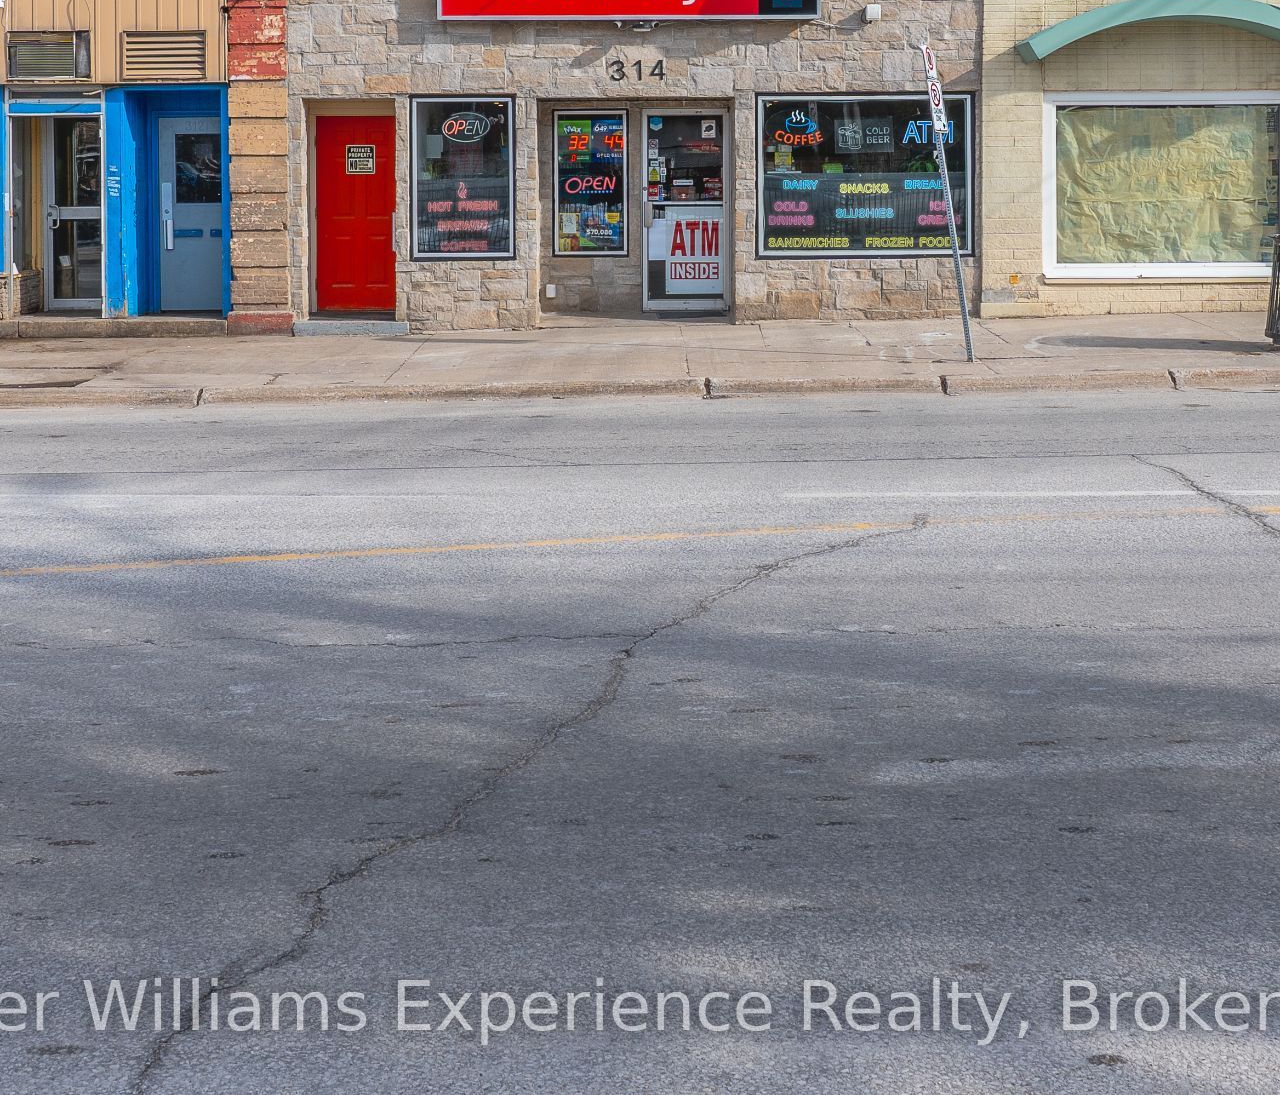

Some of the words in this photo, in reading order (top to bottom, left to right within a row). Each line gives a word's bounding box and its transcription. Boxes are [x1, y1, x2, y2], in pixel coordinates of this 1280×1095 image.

[609, 59, 666, 82] 314
[444, 119, 485, 135] OPEN
[866, 126, 890, 135] COLD
[568, 135, 589, 150] 32
[775, 130, 823, 145] COFFEE
[866, 135, 890, 144] BEER
[349, 159, 358, 170] NO
[565, 175, 616, 194] OPEN
[782, 179, 818, 190] DAIRY
[839, 182, 889, 194] SNACKS
[427, 200, 453, 212] HOT
[457, 199, 498, 212] FRESH
[773, 201, 808, 212] COLD
[835, 207, 894, 219] SLUSHIES
[768, 214, 814, 225] DRINKS
[670, 220, 719, 257] ATM
[768, 237, 849, 248] SANDWICHES
[865, 236, 914, 248] FROZEN
[671, 263, 719, 279] INSIDE
